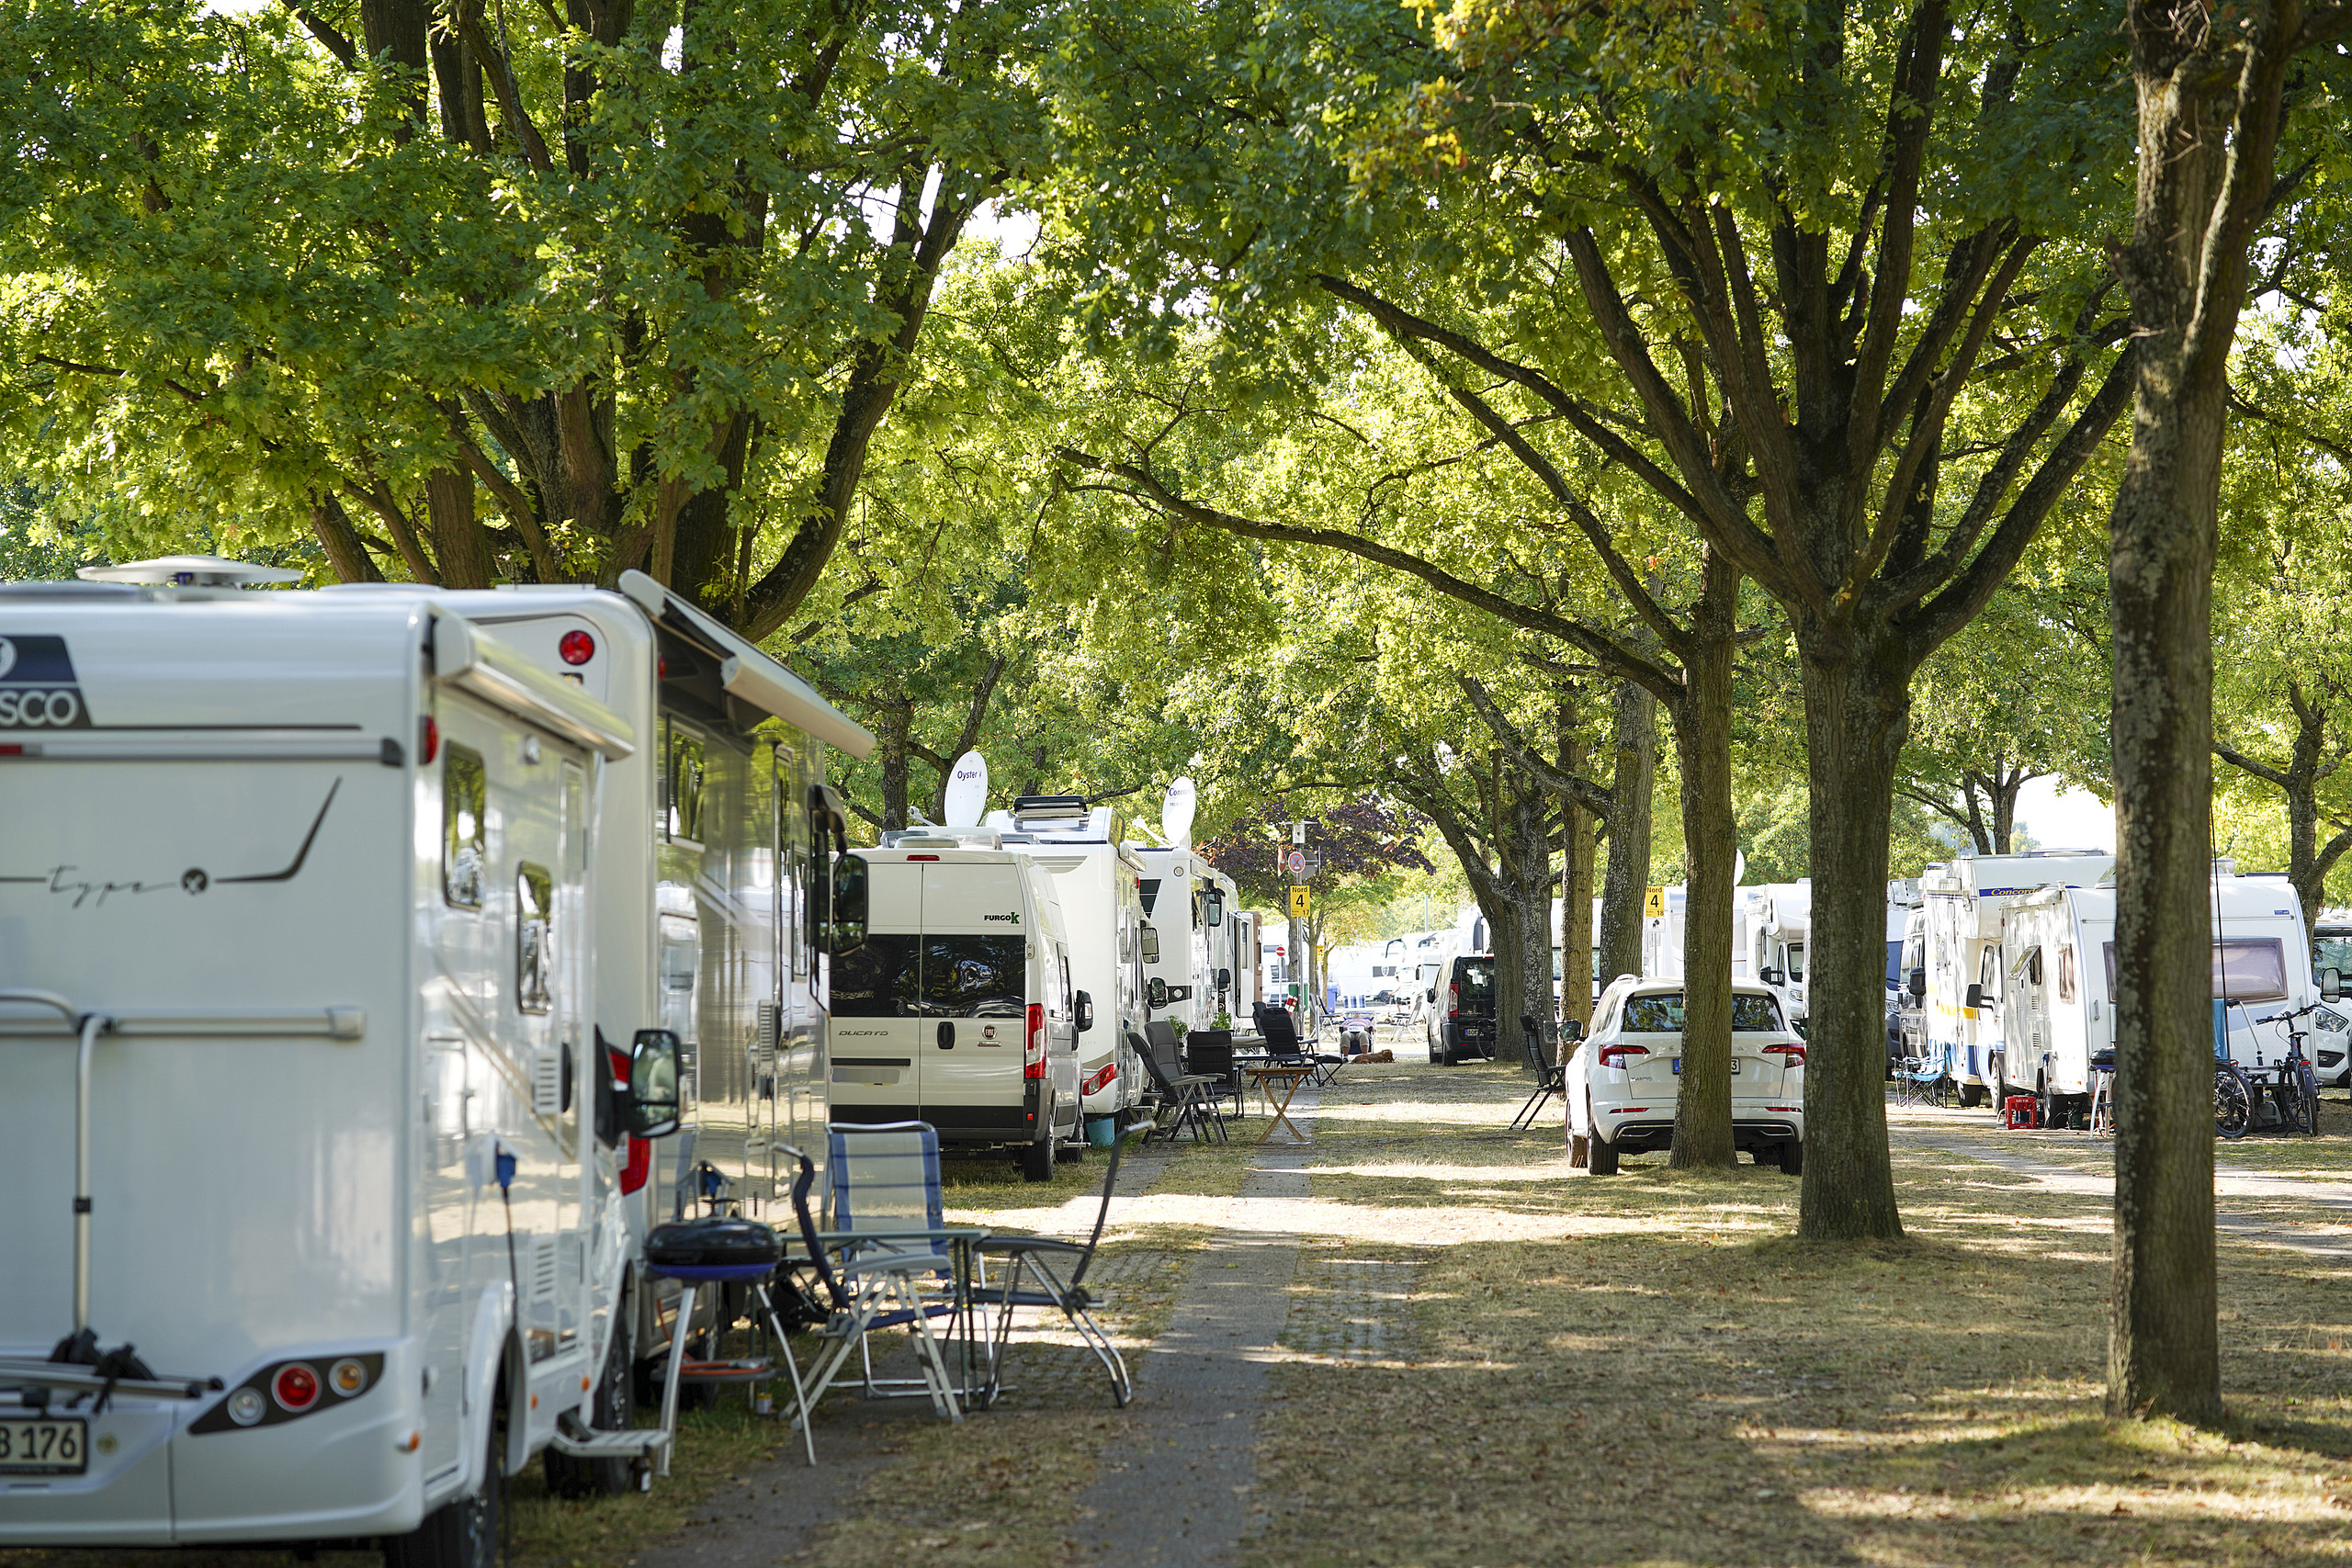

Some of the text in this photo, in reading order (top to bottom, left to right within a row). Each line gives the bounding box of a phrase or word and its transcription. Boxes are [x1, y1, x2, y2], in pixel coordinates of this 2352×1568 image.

[957, 771, 978, 781] Oyster
[1295, 894, 1305, 908] 4
[1650, 894, 1659, 908] 4
[20, 1426, 76, 1460] 176
